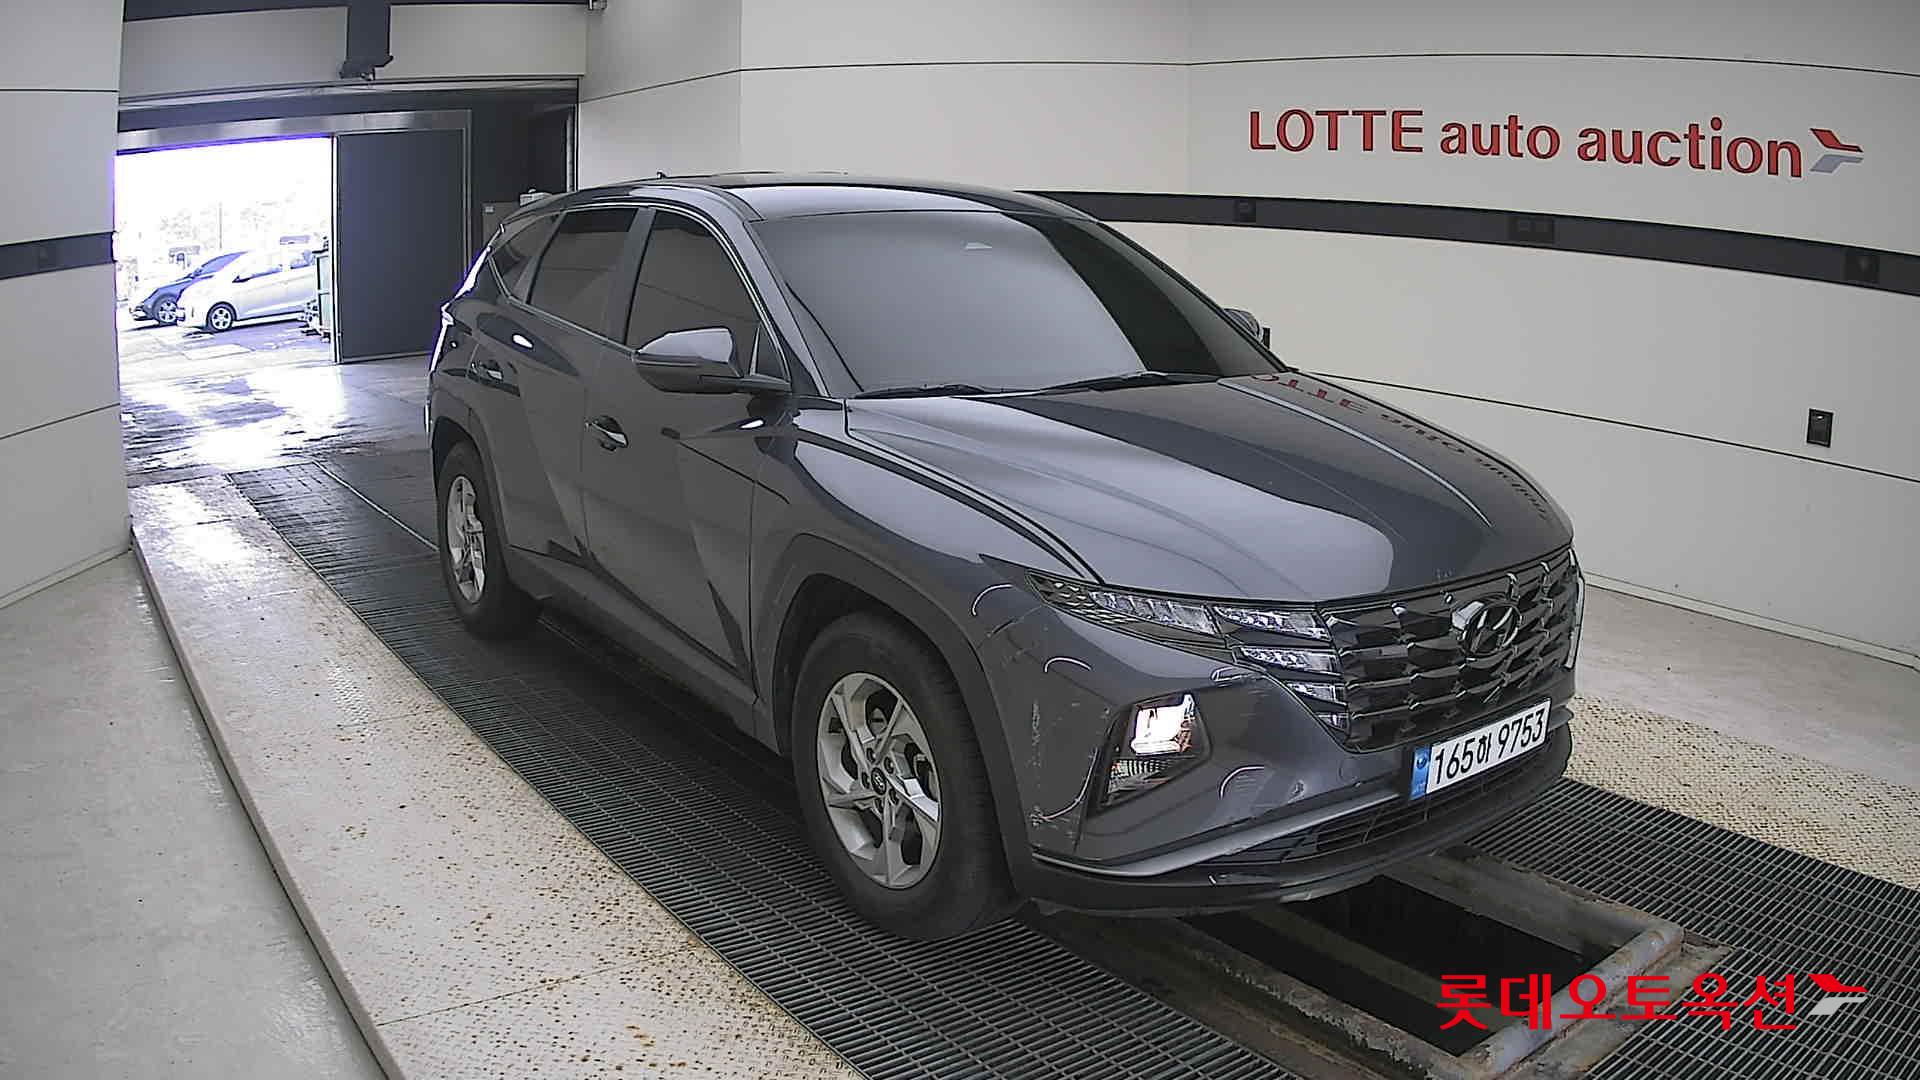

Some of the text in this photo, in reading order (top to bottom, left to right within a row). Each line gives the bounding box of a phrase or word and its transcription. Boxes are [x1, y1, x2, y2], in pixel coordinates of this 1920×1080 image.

[1249, 110, 1803, 178] LOTTE auto auction
[1435, 709, 1546, 784] 165하 9753
